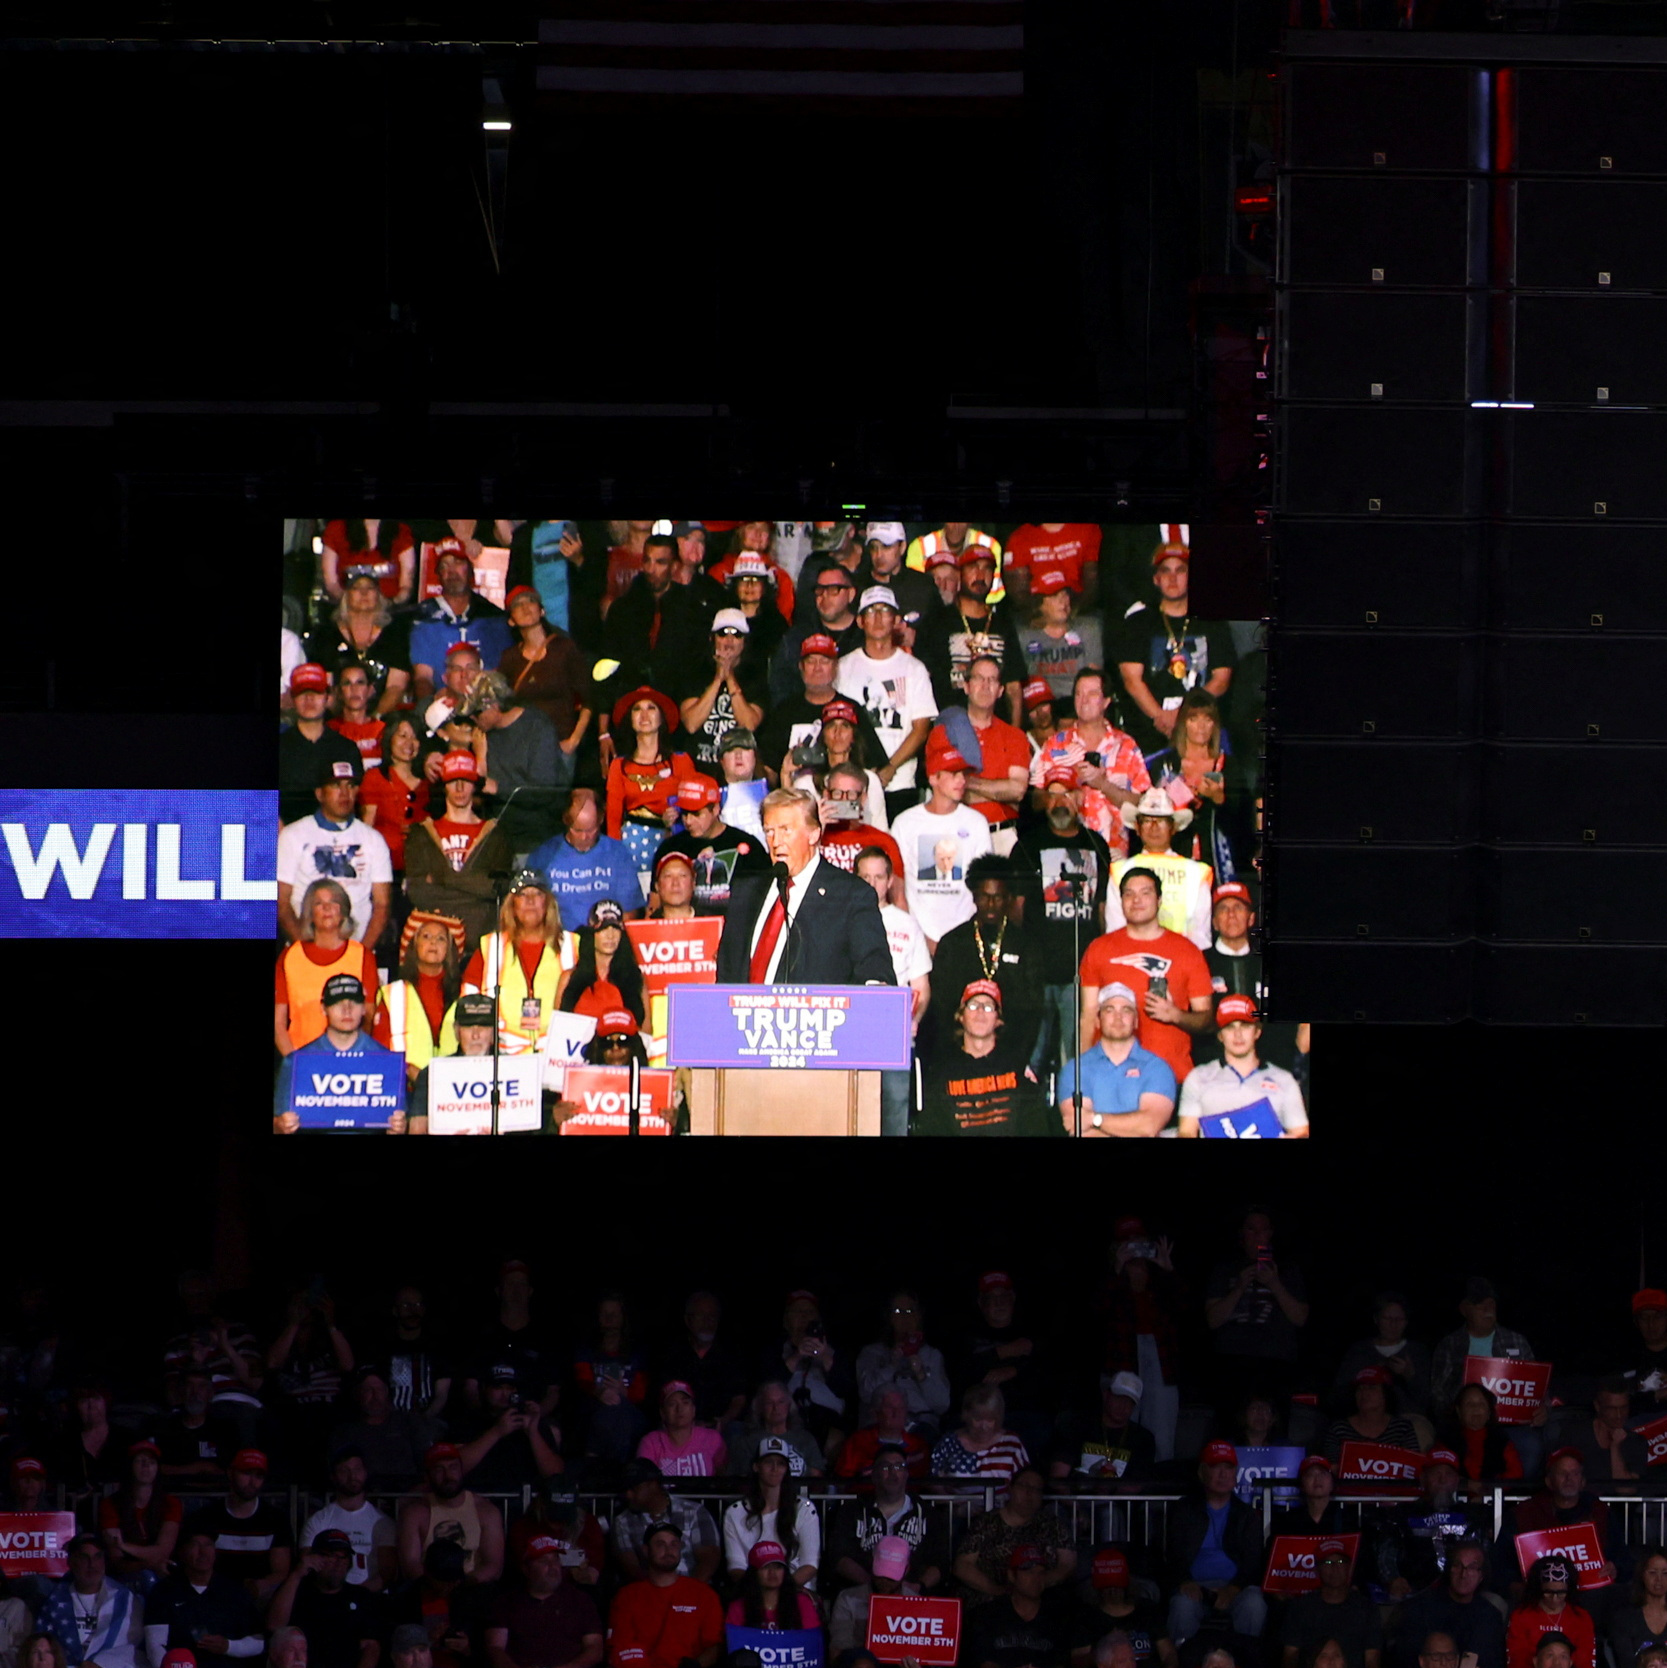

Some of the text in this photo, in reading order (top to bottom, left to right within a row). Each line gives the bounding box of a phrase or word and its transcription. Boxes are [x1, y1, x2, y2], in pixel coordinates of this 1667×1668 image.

[1, 823, 277, 901] WILL
[638, 940, 705, 963] VOTE
[732, 1009, 847, 1031] TRUMP
[743, 1030, 833, 1050] VANCE
[769, 1056, 806, 1069] 2024
[312, 1073, 384, 1095] VOTE
[295, 1095, 397, 1108] NOVEMBER 5TH
[640, 1115, 665, 1128] 5TH
[1358, 1457, 1417, 1480] VOTE
[0, 1531, 58, 1550] VOTE
[886, 1615, 944, 1636] VOTE
[872, 1633, 954, 1648] NOVEMBER 5TH
